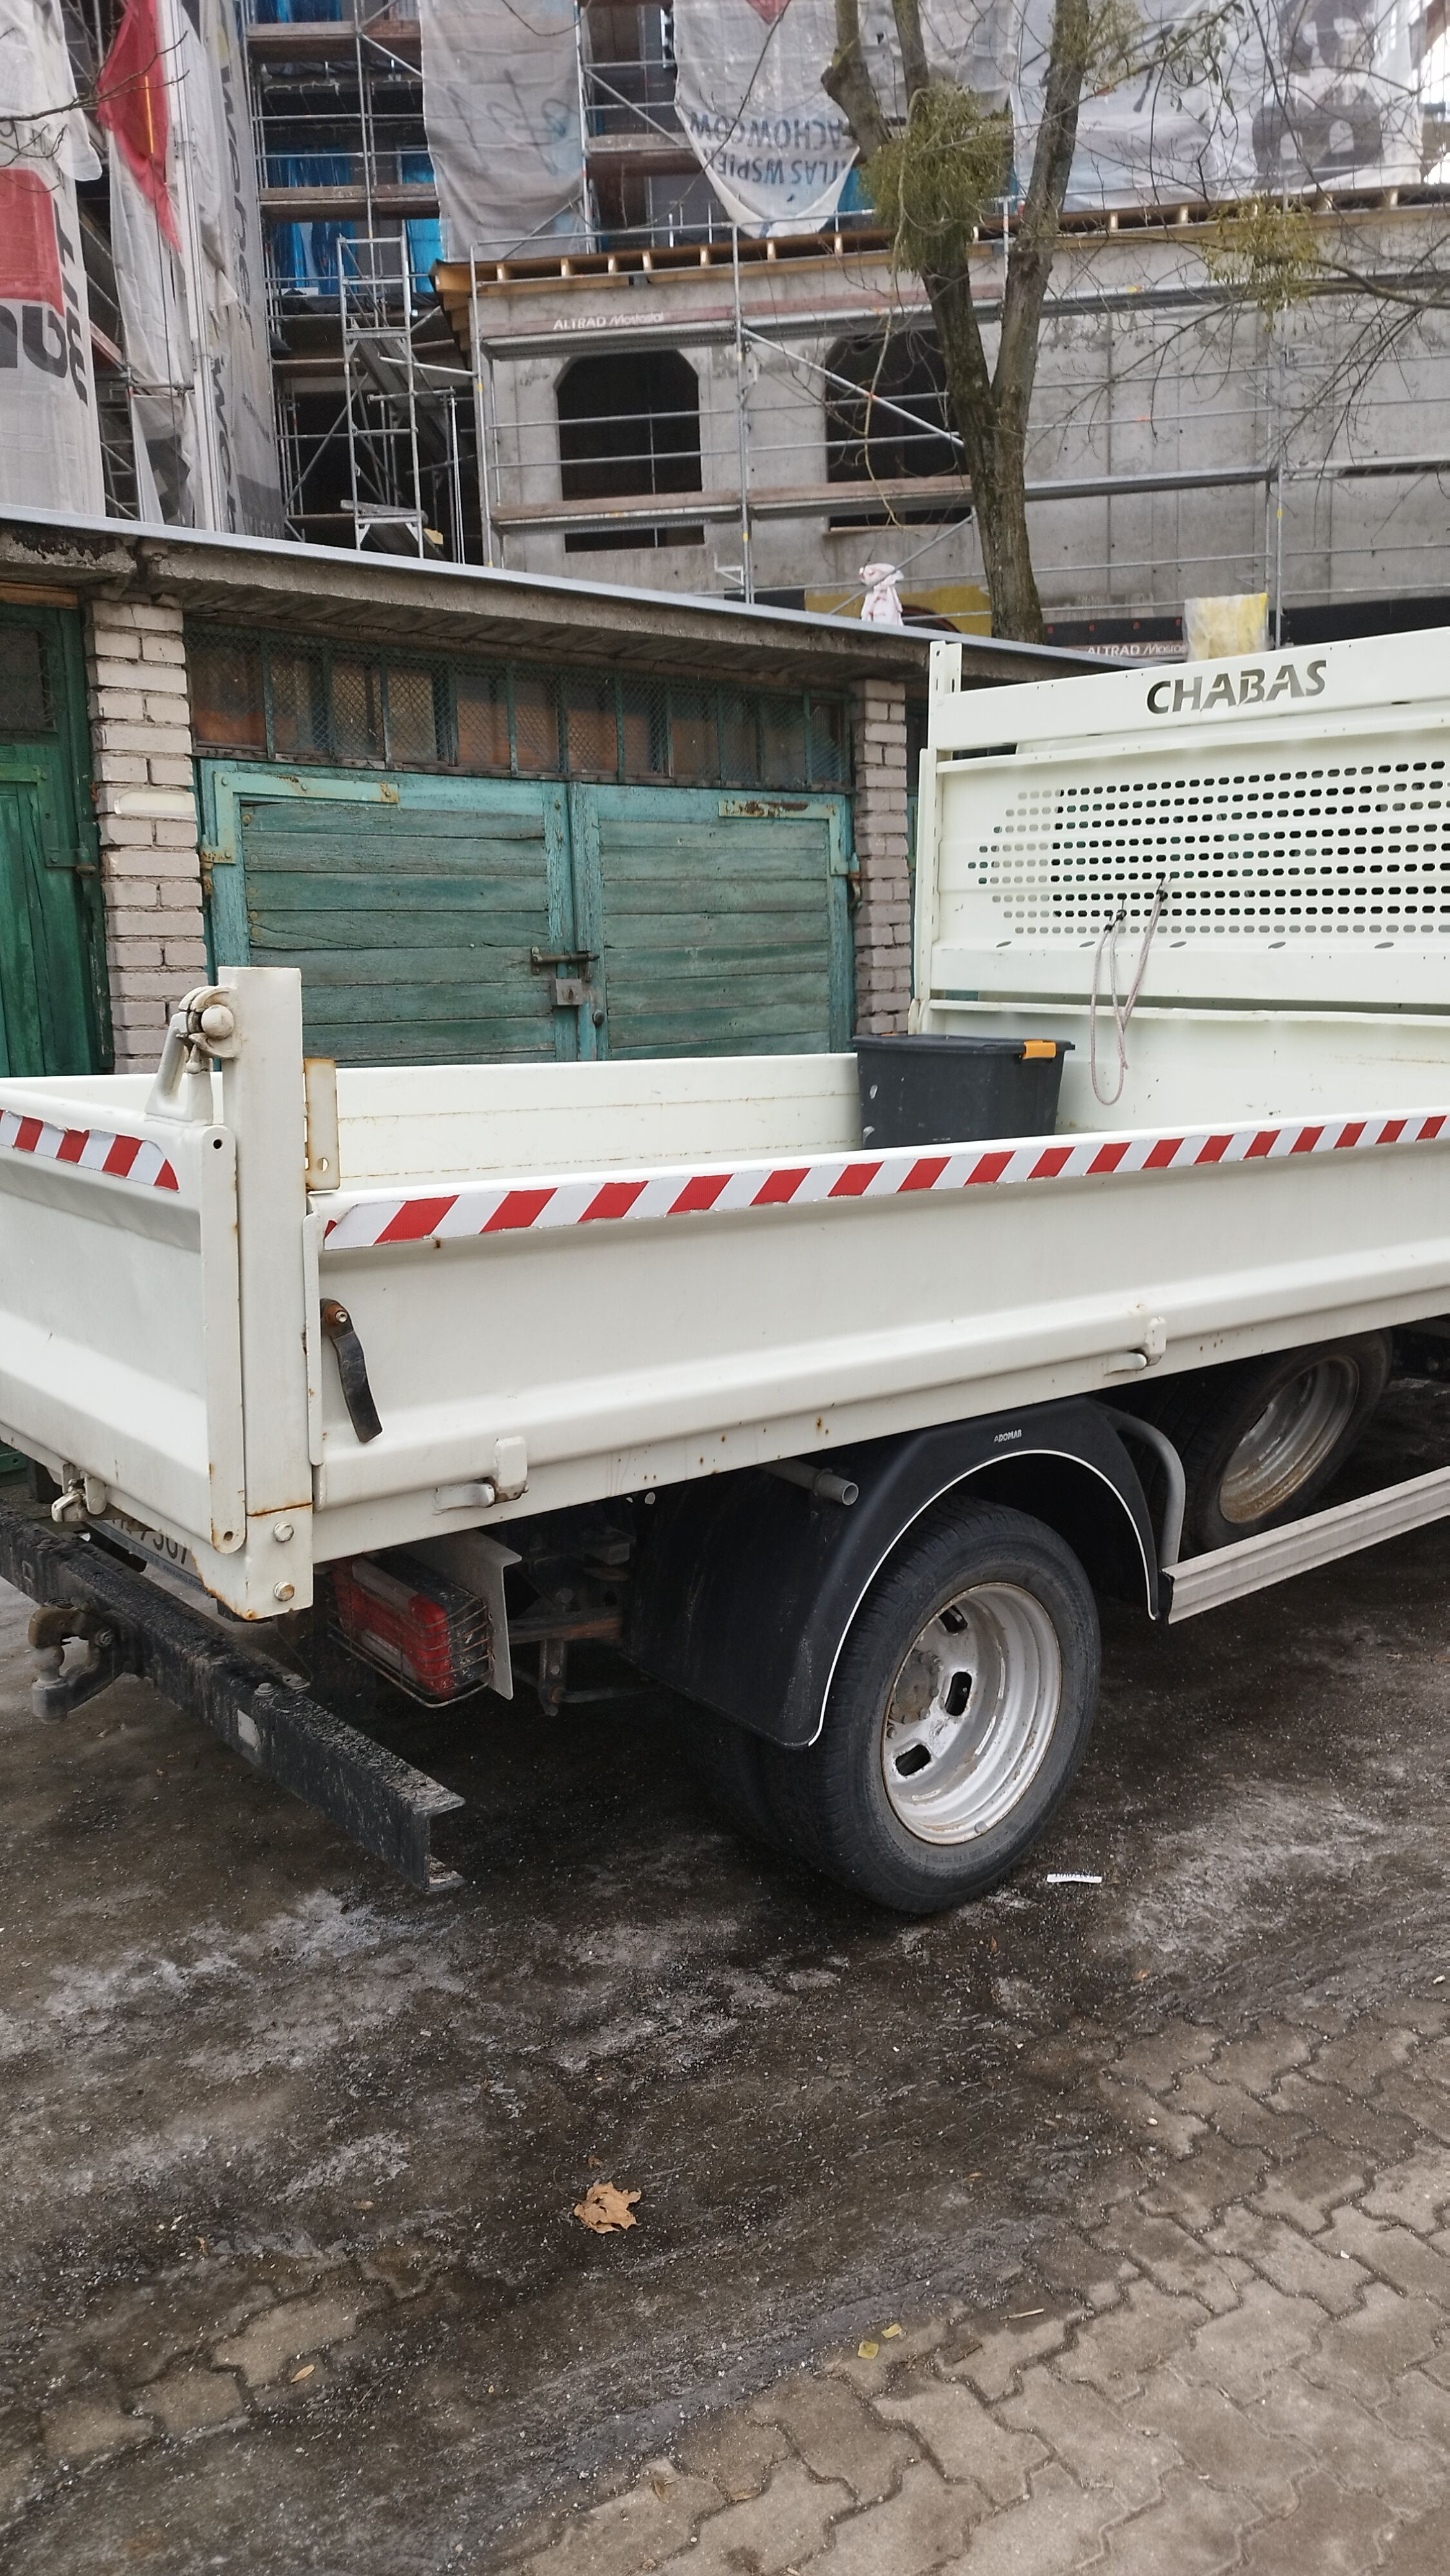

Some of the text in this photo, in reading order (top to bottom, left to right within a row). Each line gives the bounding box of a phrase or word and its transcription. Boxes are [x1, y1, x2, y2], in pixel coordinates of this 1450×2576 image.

[553, 316, 607, 330] ALTRAD
[1088, 645, 1140, 657] ALTRAD
[1147, 659, 1326, 714] CHABAS
